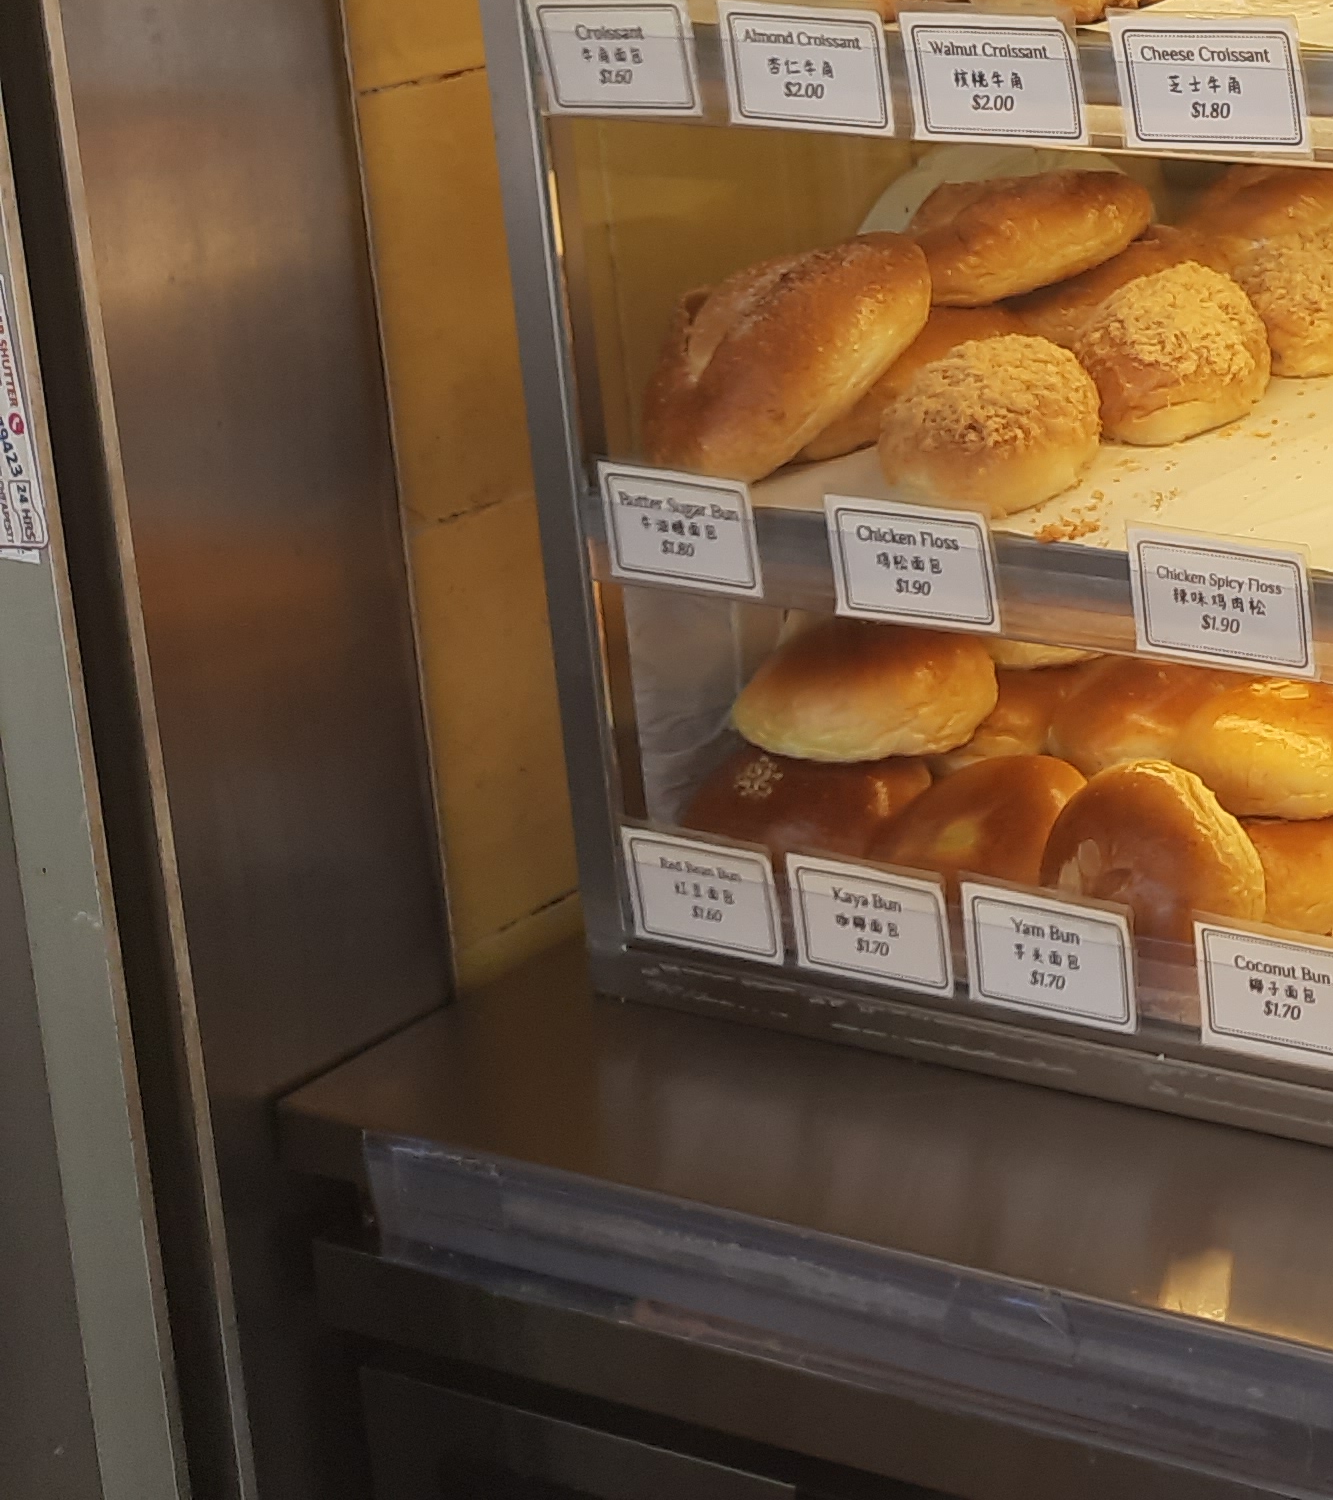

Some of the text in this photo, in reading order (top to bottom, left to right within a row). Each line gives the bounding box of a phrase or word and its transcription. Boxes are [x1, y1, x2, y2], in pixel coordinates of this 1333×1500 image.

[798, 32, 861, 50] Croissant
[928, 41, 1049, 59] Walnut Croissant
[1141, 46, 1270, 63] Cheese Croissant
[972, 94, 1014, 111] $2.00
[1191, 101, 1230, 118] $1.80
[1157, 566, 1244, 592] Chicken Spicy
[1202, 614, 1240, 633] $1.90
[1011, 917, 1080, 945] Yam Bun
[1234, 955, 1330, 984] Coconut Bun
[1030, 970, 1065, 990] $1.70
[1264, 1000, 1301, 1020] $1.70
